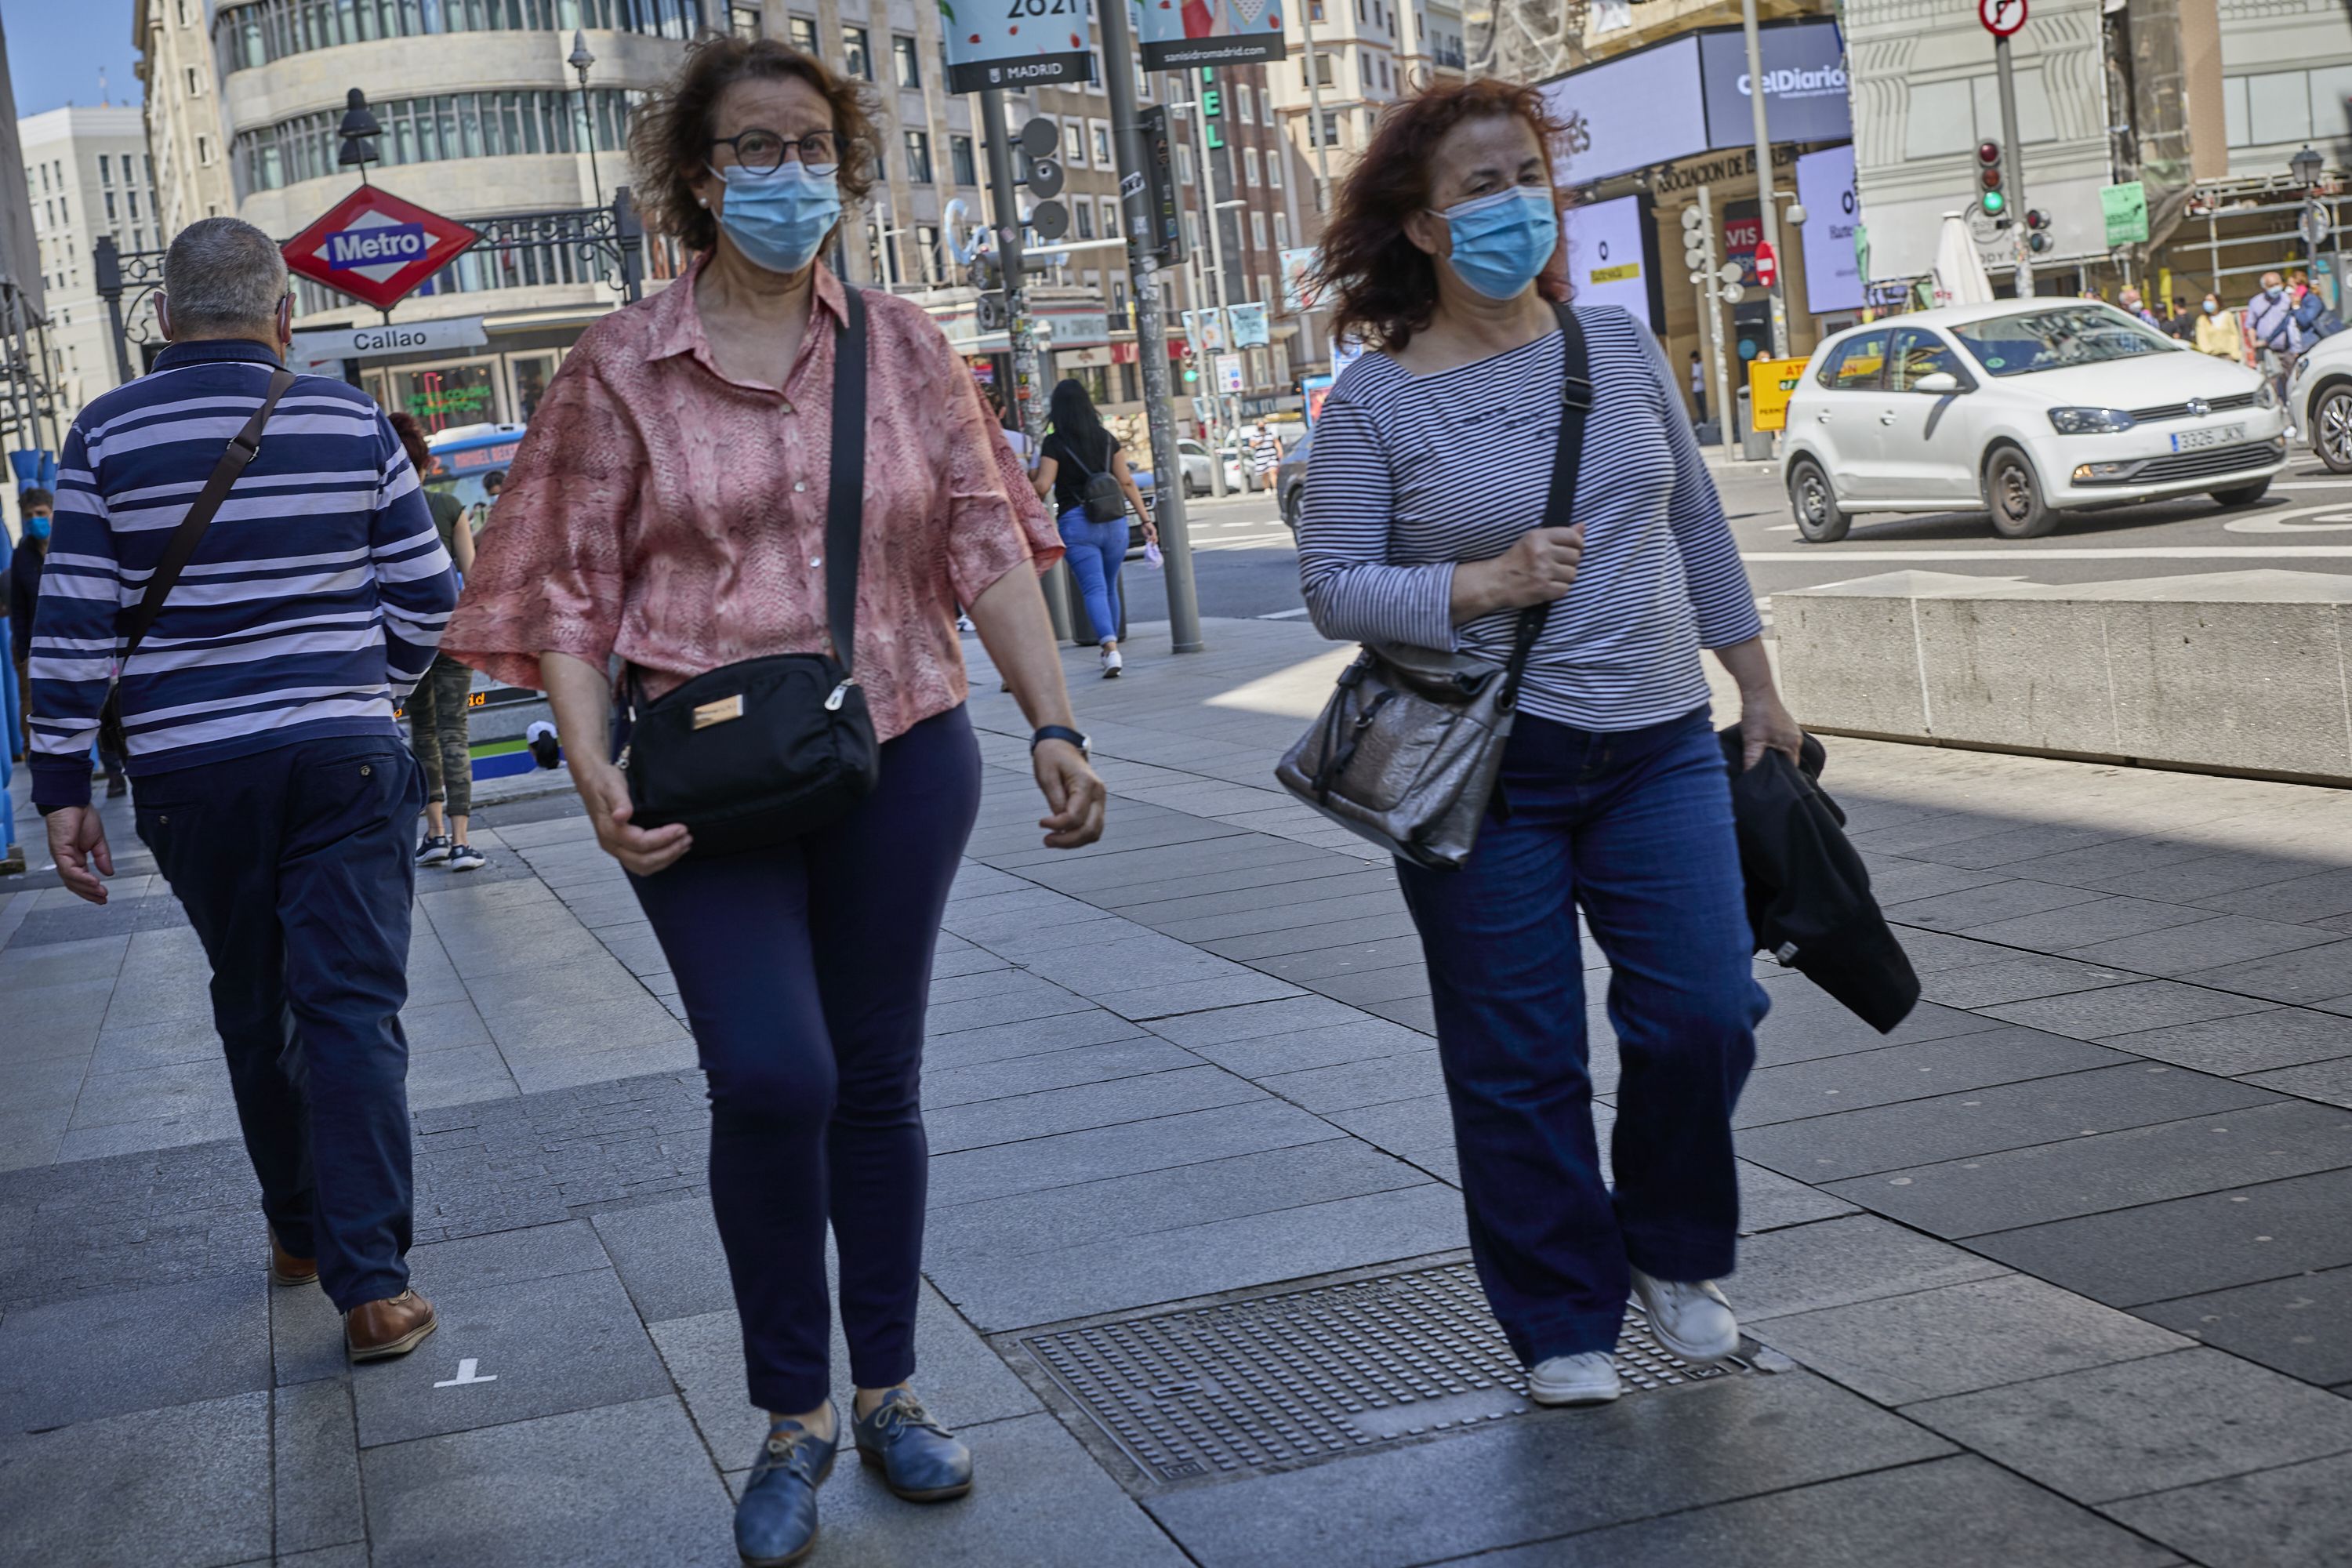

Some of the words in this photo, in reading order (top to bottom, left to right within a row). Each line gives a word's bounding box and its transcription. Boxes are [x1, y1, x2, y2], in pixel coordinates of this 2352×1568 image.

[1163, 45, 1267, 63] sanisidromadrid.com
[1007, 62, 1063, 80] MADRID
[333, 232, 421, 262] Metro
[354, 332, 426, 351] Callao
